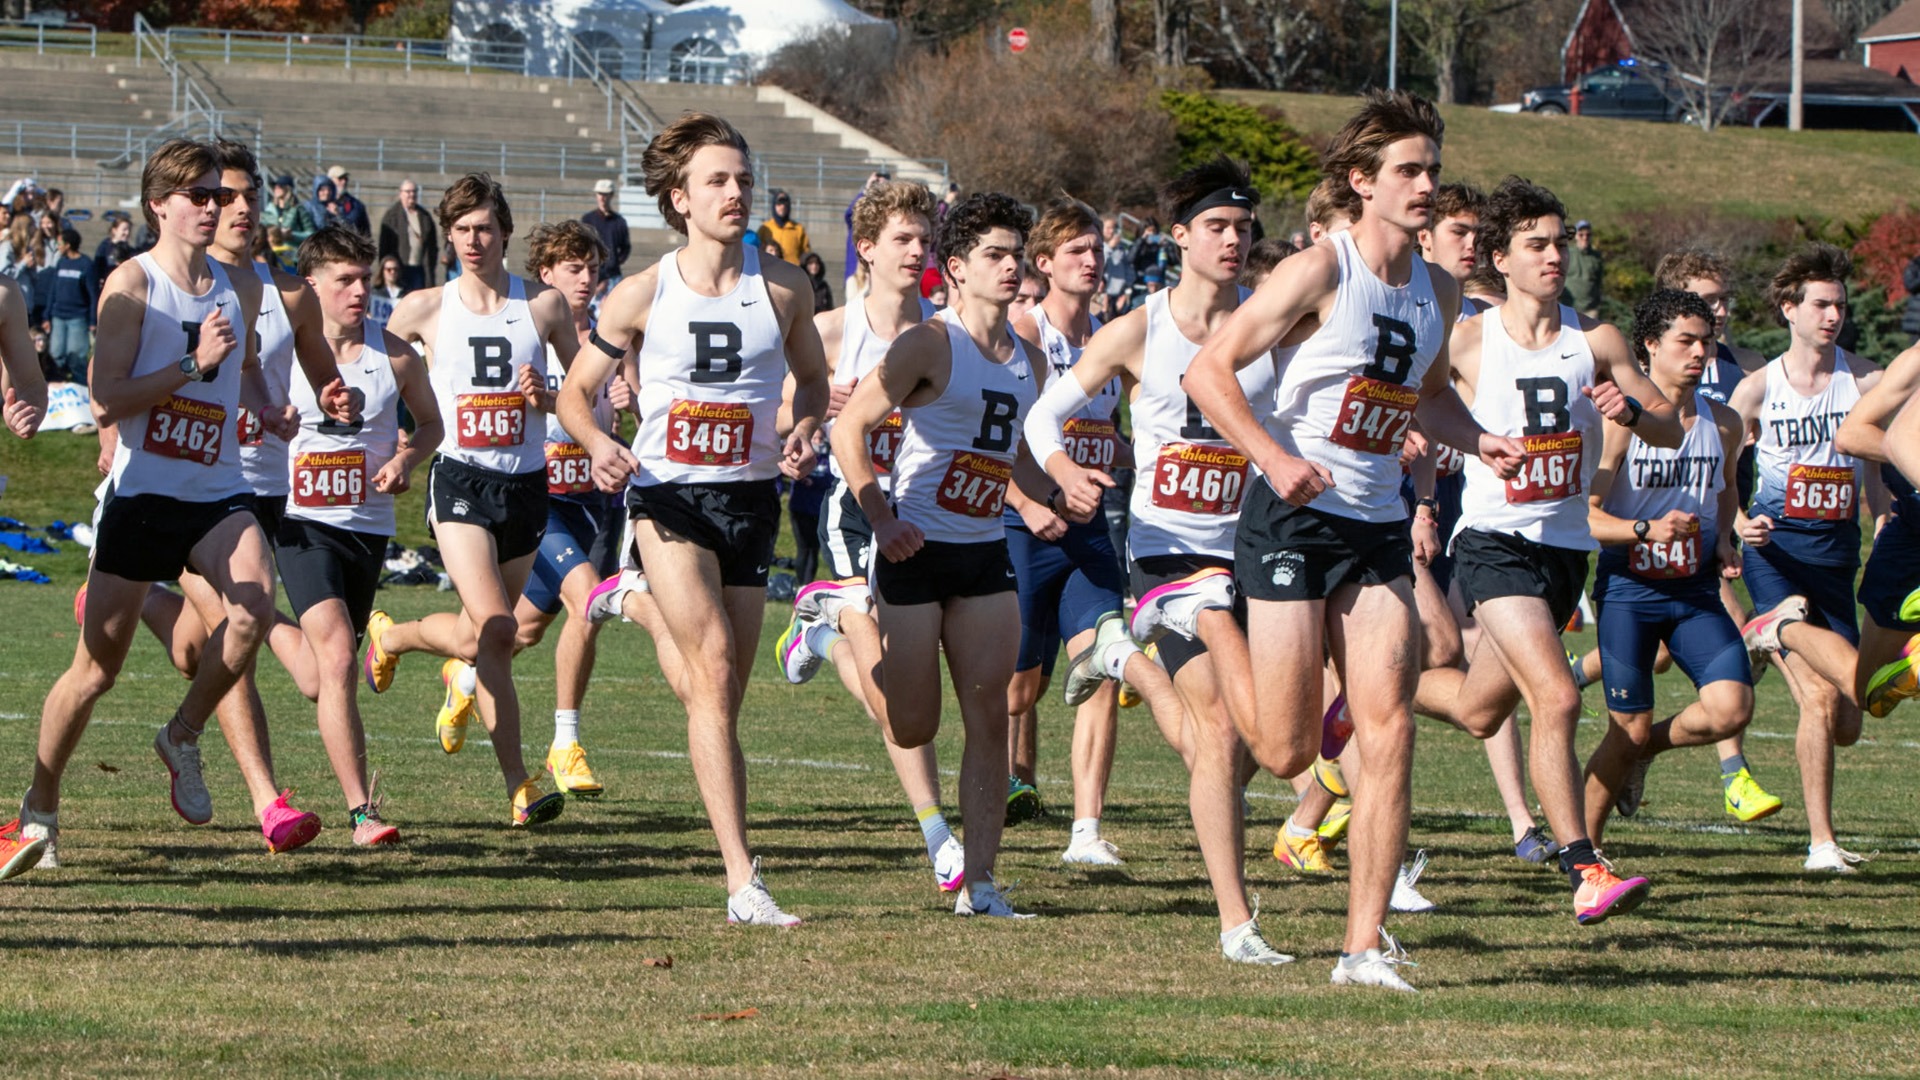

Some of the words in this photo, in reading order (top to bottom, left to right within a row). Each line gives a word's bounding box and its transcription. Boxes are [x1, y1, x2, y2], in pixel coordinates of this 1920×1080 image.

[468, 336, 513, 387] B
[689, 321, 742, 383] B
[1363, 313, 1416, 384] B
[462, 409, 523, 437] 3463
[972, 388, 1018, 452] B
[1342, 400, 1411, 443] 3472
[1516, 376, 1571, 435] B
[152, 412, 220, 454] 3462
[672, 420, 745, 454] 3461
[1770, 410, 1851, 447] TRINIT
[1064, 437, 1115, 466] 3630
[298, 468, 362, 497] 3466
[944, 469, 1006, 513] 3473
[1160, 462, 1241, 502] 3460
[1511, 452, 1579, 491] 3467
[1633, 455, 1720, 488] TRINITY
[1790, 481, 1853, 510] 3639
[1634, 537, 1698, 571] 3641
